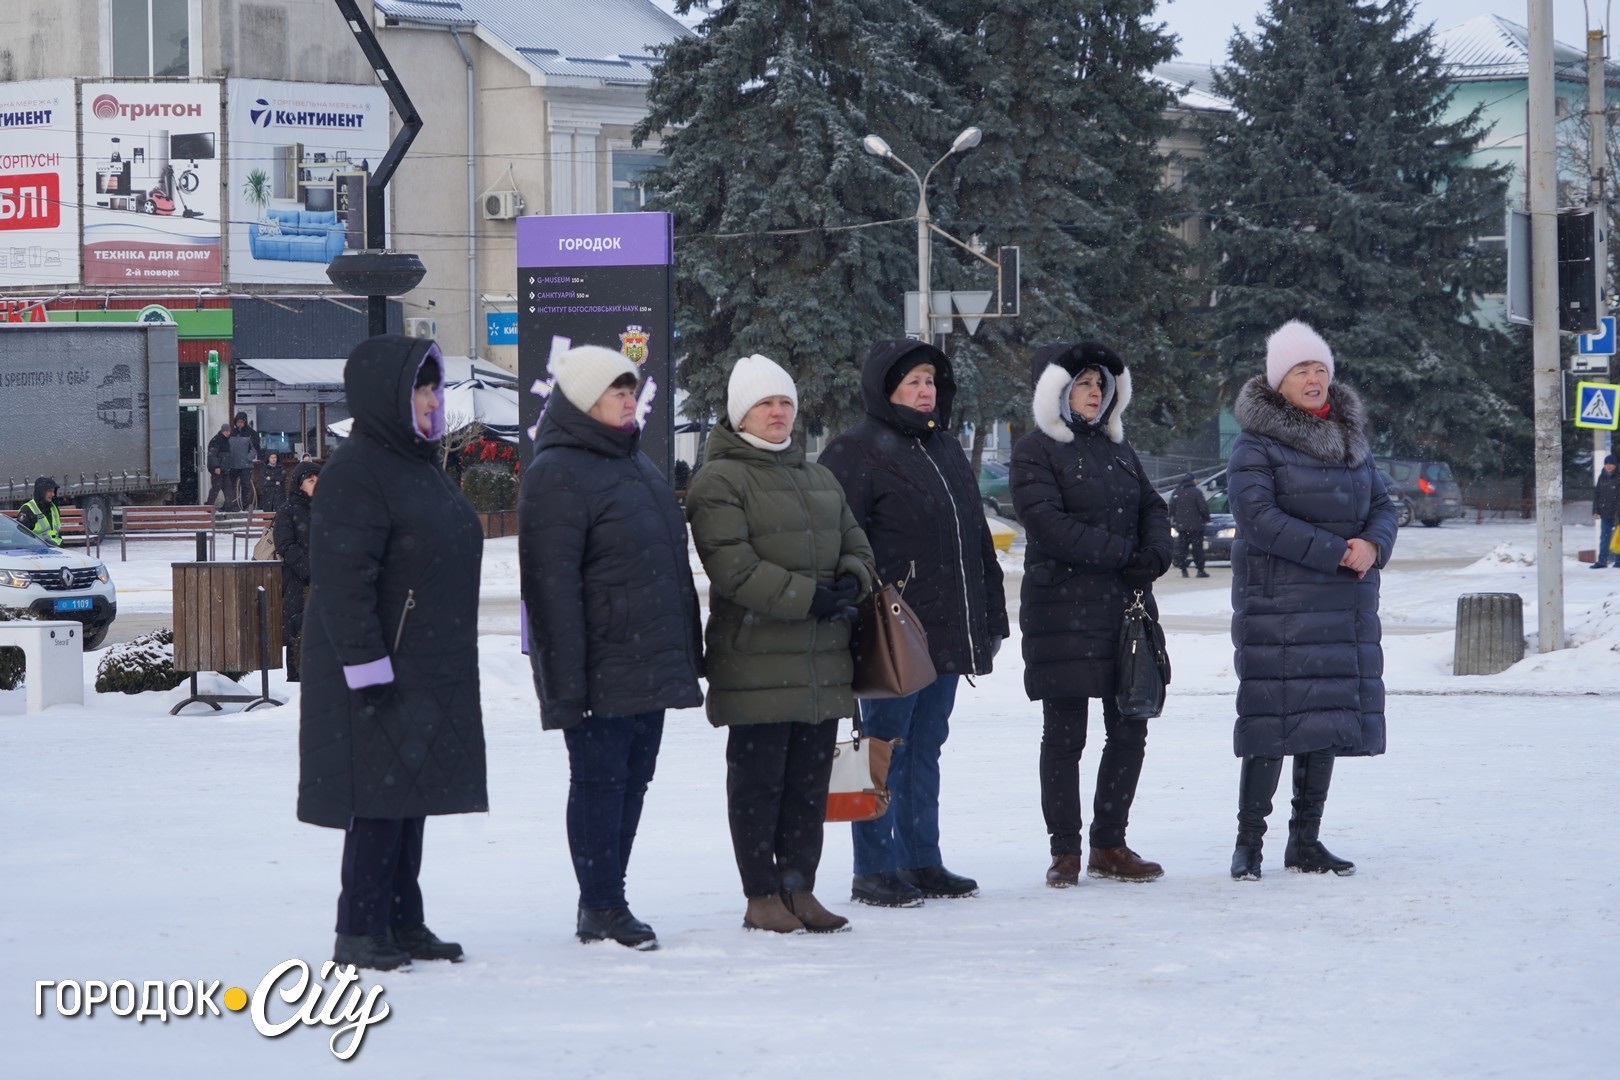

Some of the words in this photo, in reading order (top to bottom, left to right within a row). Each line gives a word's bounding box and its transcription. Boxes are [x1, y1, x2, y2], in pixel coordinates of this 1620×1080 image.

[329, 102, 364, 110] МЕРЕЖА
[119, 103, 202, 121] тритон
[276, 110, 364, 128] КОНТИНЕНТ
[558, 237, 622, 252] ГОРОДОК
[94, 250, 146, 260] ТЕХНІКА
[148, 250, 173, 261] ДЛЯ
[177, 250, 211, 261] ДОМУ
[125, 268, 142, 276] 2-й
[144, 268, 180, 278] поверх
[537, 276, 571, 284] G-MUSEUM
[537, 290, 576, 299] САНКТУАРІЙ
[568, 305, 622, 313] БОГОСЛОВСЬКИХ
[72, 599, 89, 609] 1109
